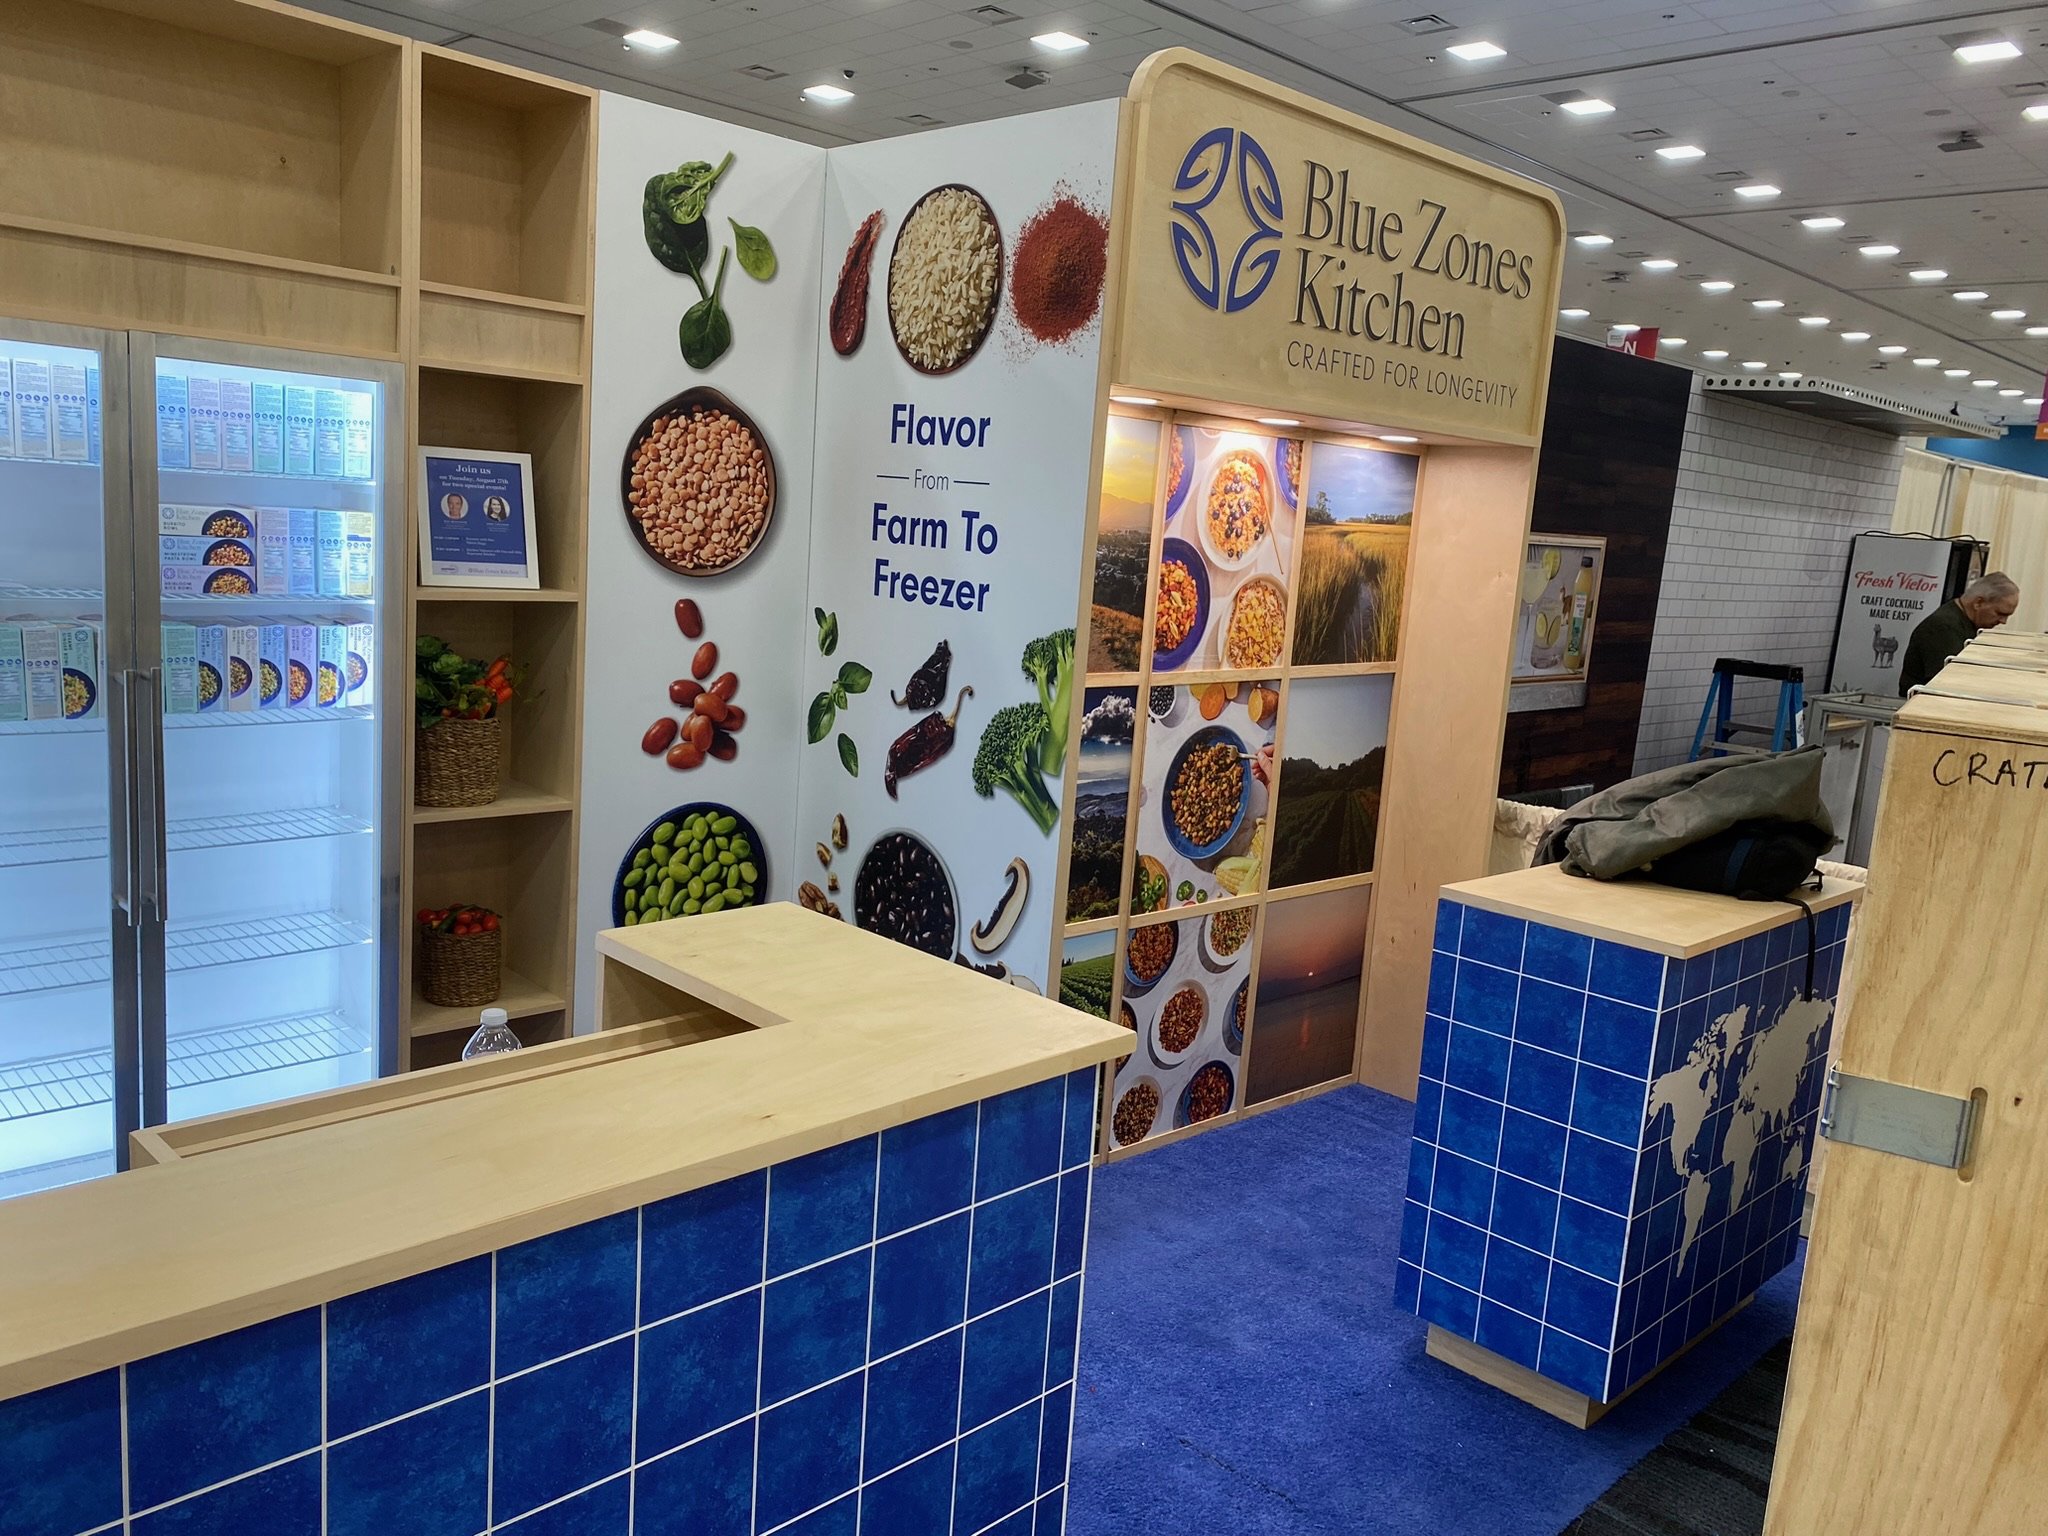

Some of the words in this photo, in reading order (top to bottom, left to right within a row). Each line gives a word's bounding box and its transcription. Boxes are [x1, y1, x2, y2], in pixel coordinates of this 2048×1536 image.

[1300, 159, 1403, 262] Blue
[1412, 198, 1534, 299] Zones
[1289, 247, 1466, 359] Kitchen
[1287, 340, 1375, 381] CRAFTED
[1383, 360, 1419, 390] FOR
[1426, 369, 1518, 409] LONGEVITY
[891, 403, 991, 447] Flavor
[455, 464, 477, 474] Join
[914, 468, 949, 491] From
[872, 502, 948, 549] Farm
[961, 510, 998, 555] To
[873, 558, 990, 612] Freezer
[1855, 571, 1894, 589] Fresh
[1896, 571, 1938, 592] Victor
[1861, 595, 1883, 606] CRAFT
[1885, 597, 1925, 610] COCKTAILS
[1869, 608, 1890, 619] MADE
[1892, 610, 1912, 621] EASY
[1933, 749, 2048, 789] CRAT
